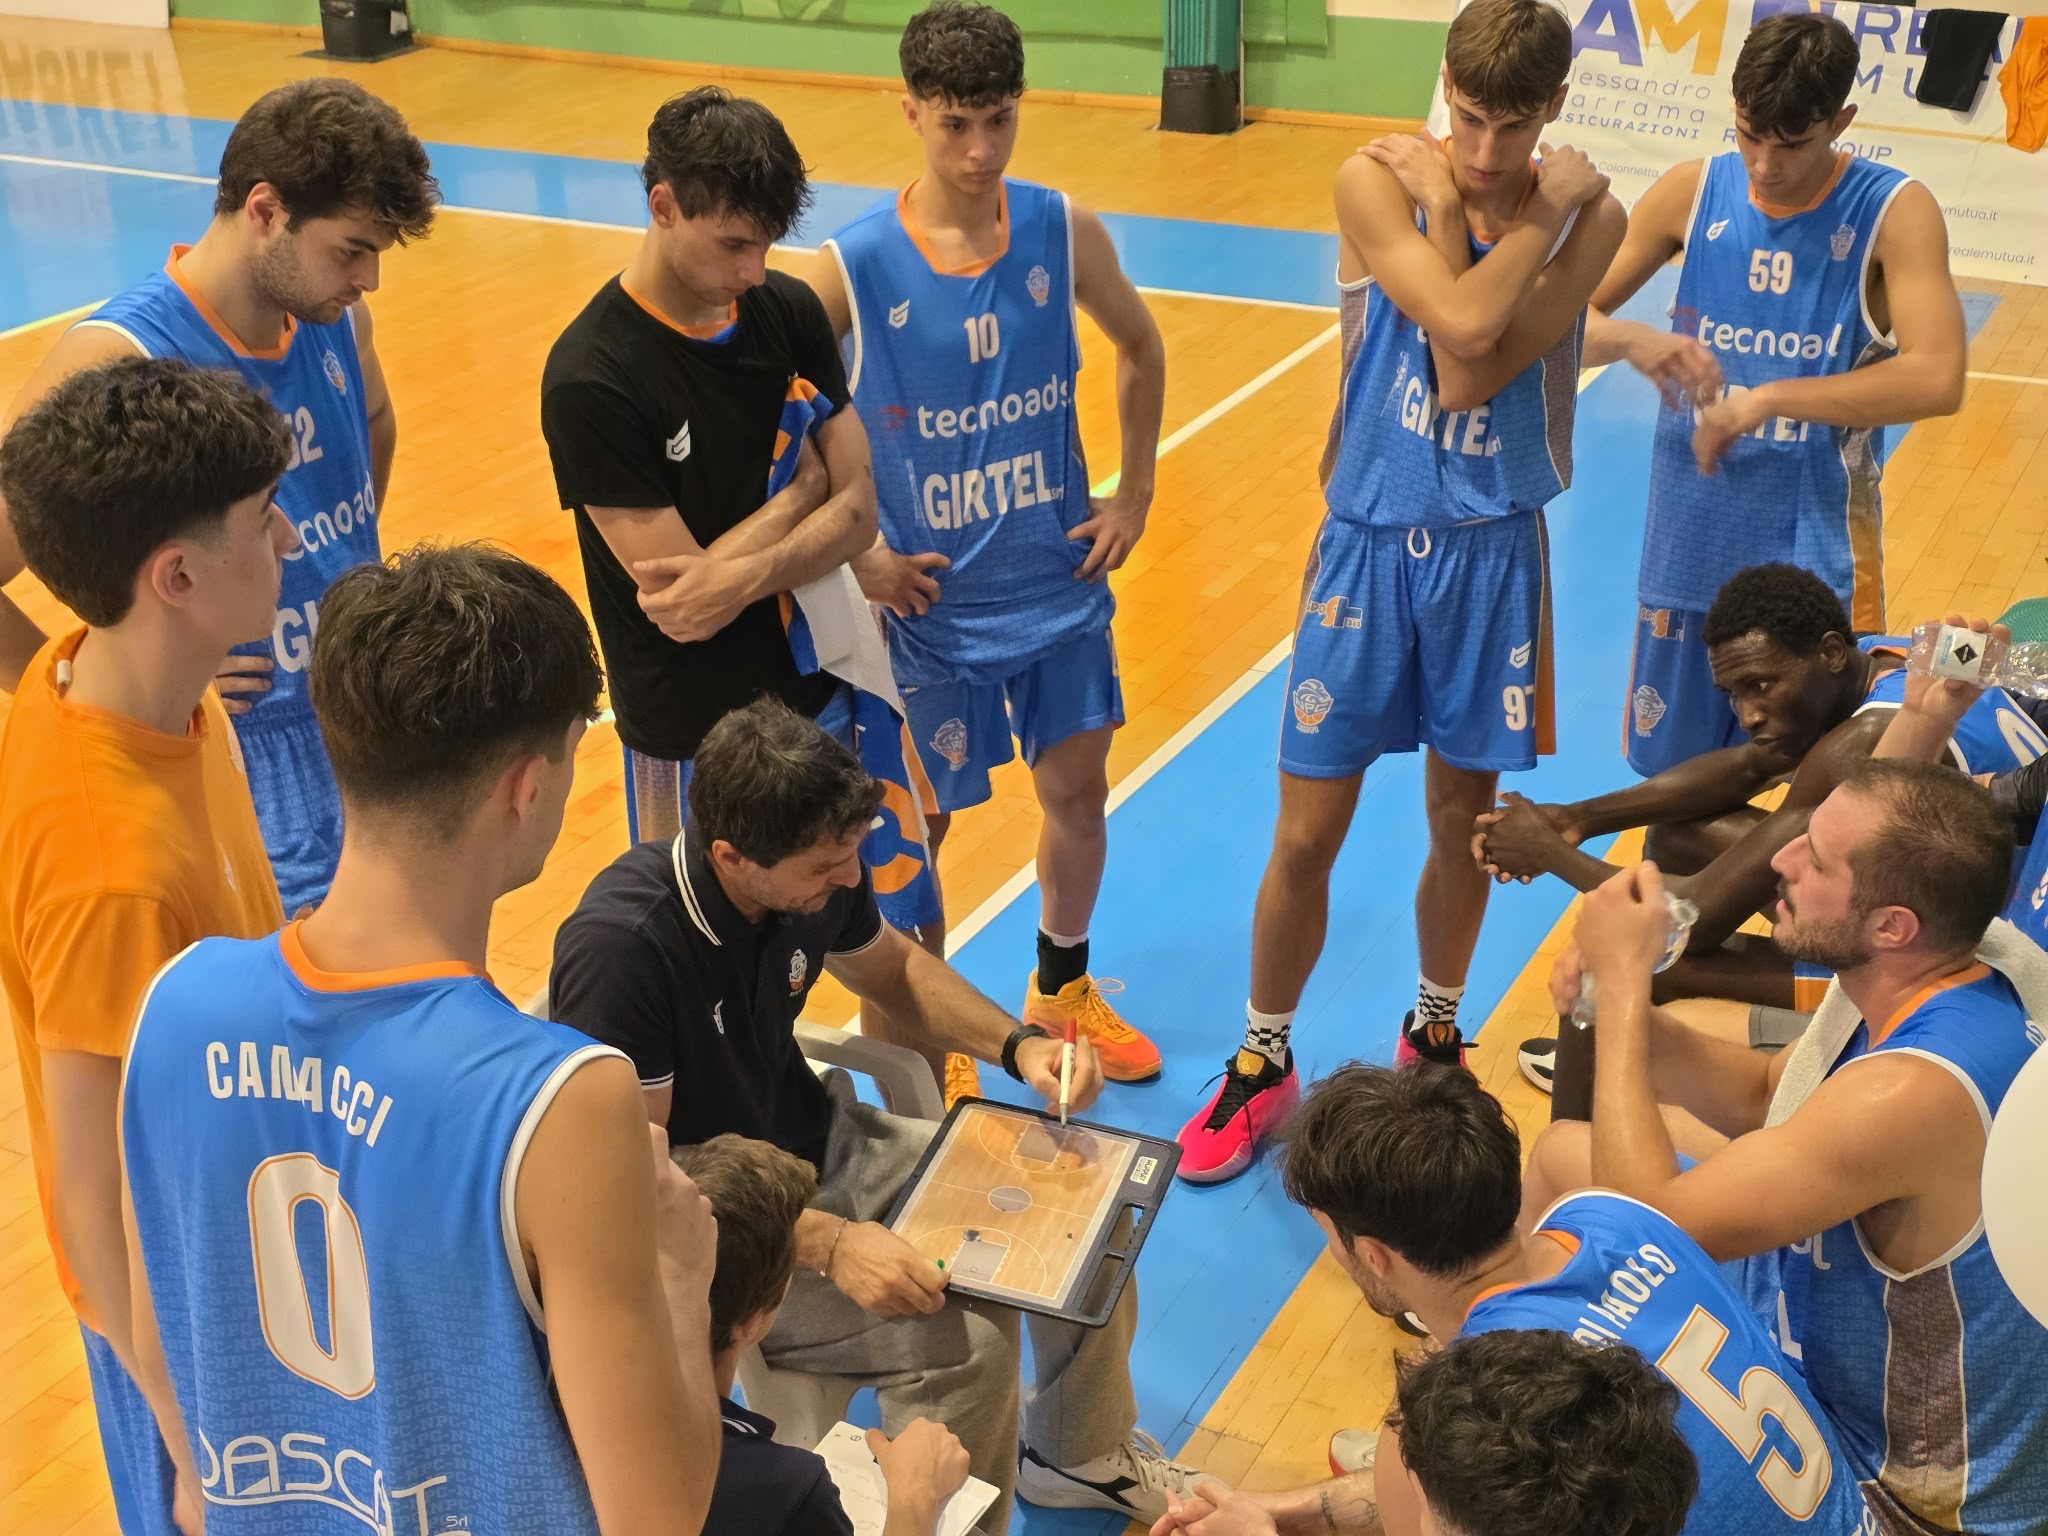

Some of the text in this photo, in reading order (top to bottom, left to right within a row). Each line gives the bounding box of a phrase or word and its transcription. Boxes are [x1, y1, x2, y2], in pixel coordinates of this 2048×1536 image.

[1571, 66, 1711, 100] lessandro
[1571, 94, 1705, 123] arrama
[1940, 207, 1998, 221] mutua.it
[1749, 248, 1793, 295] 59
[963, 312, 1000, 364] 10
[923, 450, 1052, 529] GIRTEL
[248, 1152, 376, 1401] 0
[1655, 1303, 1833, 1522] 5
[446, 1515, 468, 1528] Srl
